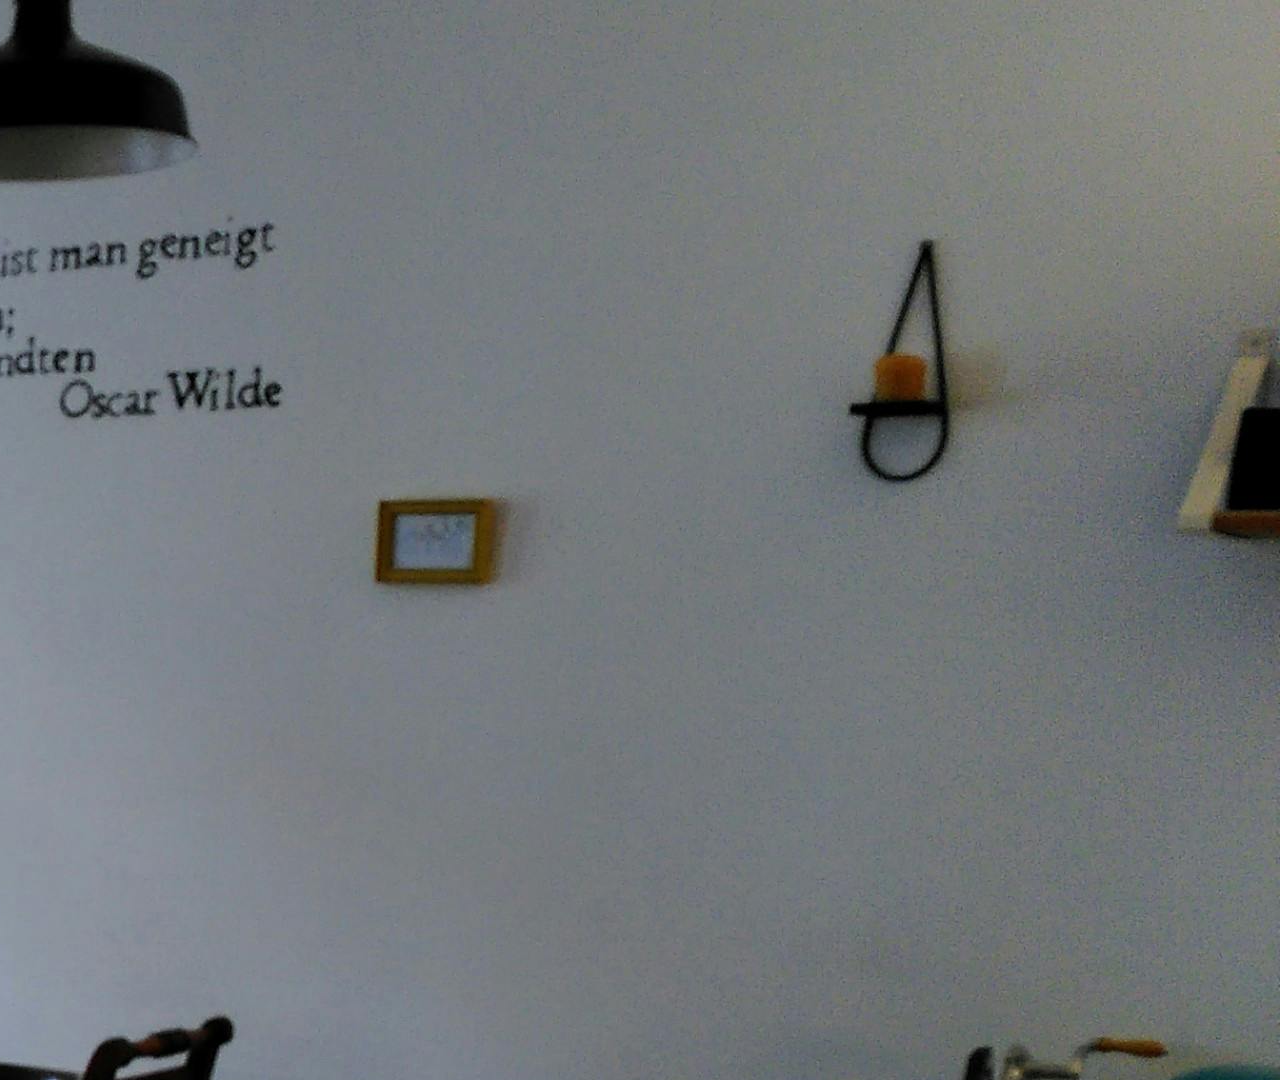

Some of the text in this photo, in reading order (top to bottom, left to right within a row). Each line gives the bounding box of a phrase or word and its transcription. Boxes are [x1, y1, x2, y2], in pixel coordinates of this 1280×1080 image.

[0, 238, 40, 278] ist
[49, 241, 128, 273] man
[135, 215, 276, 279] geneigt
[59, 364, 284, 418] Oscar Wilde
